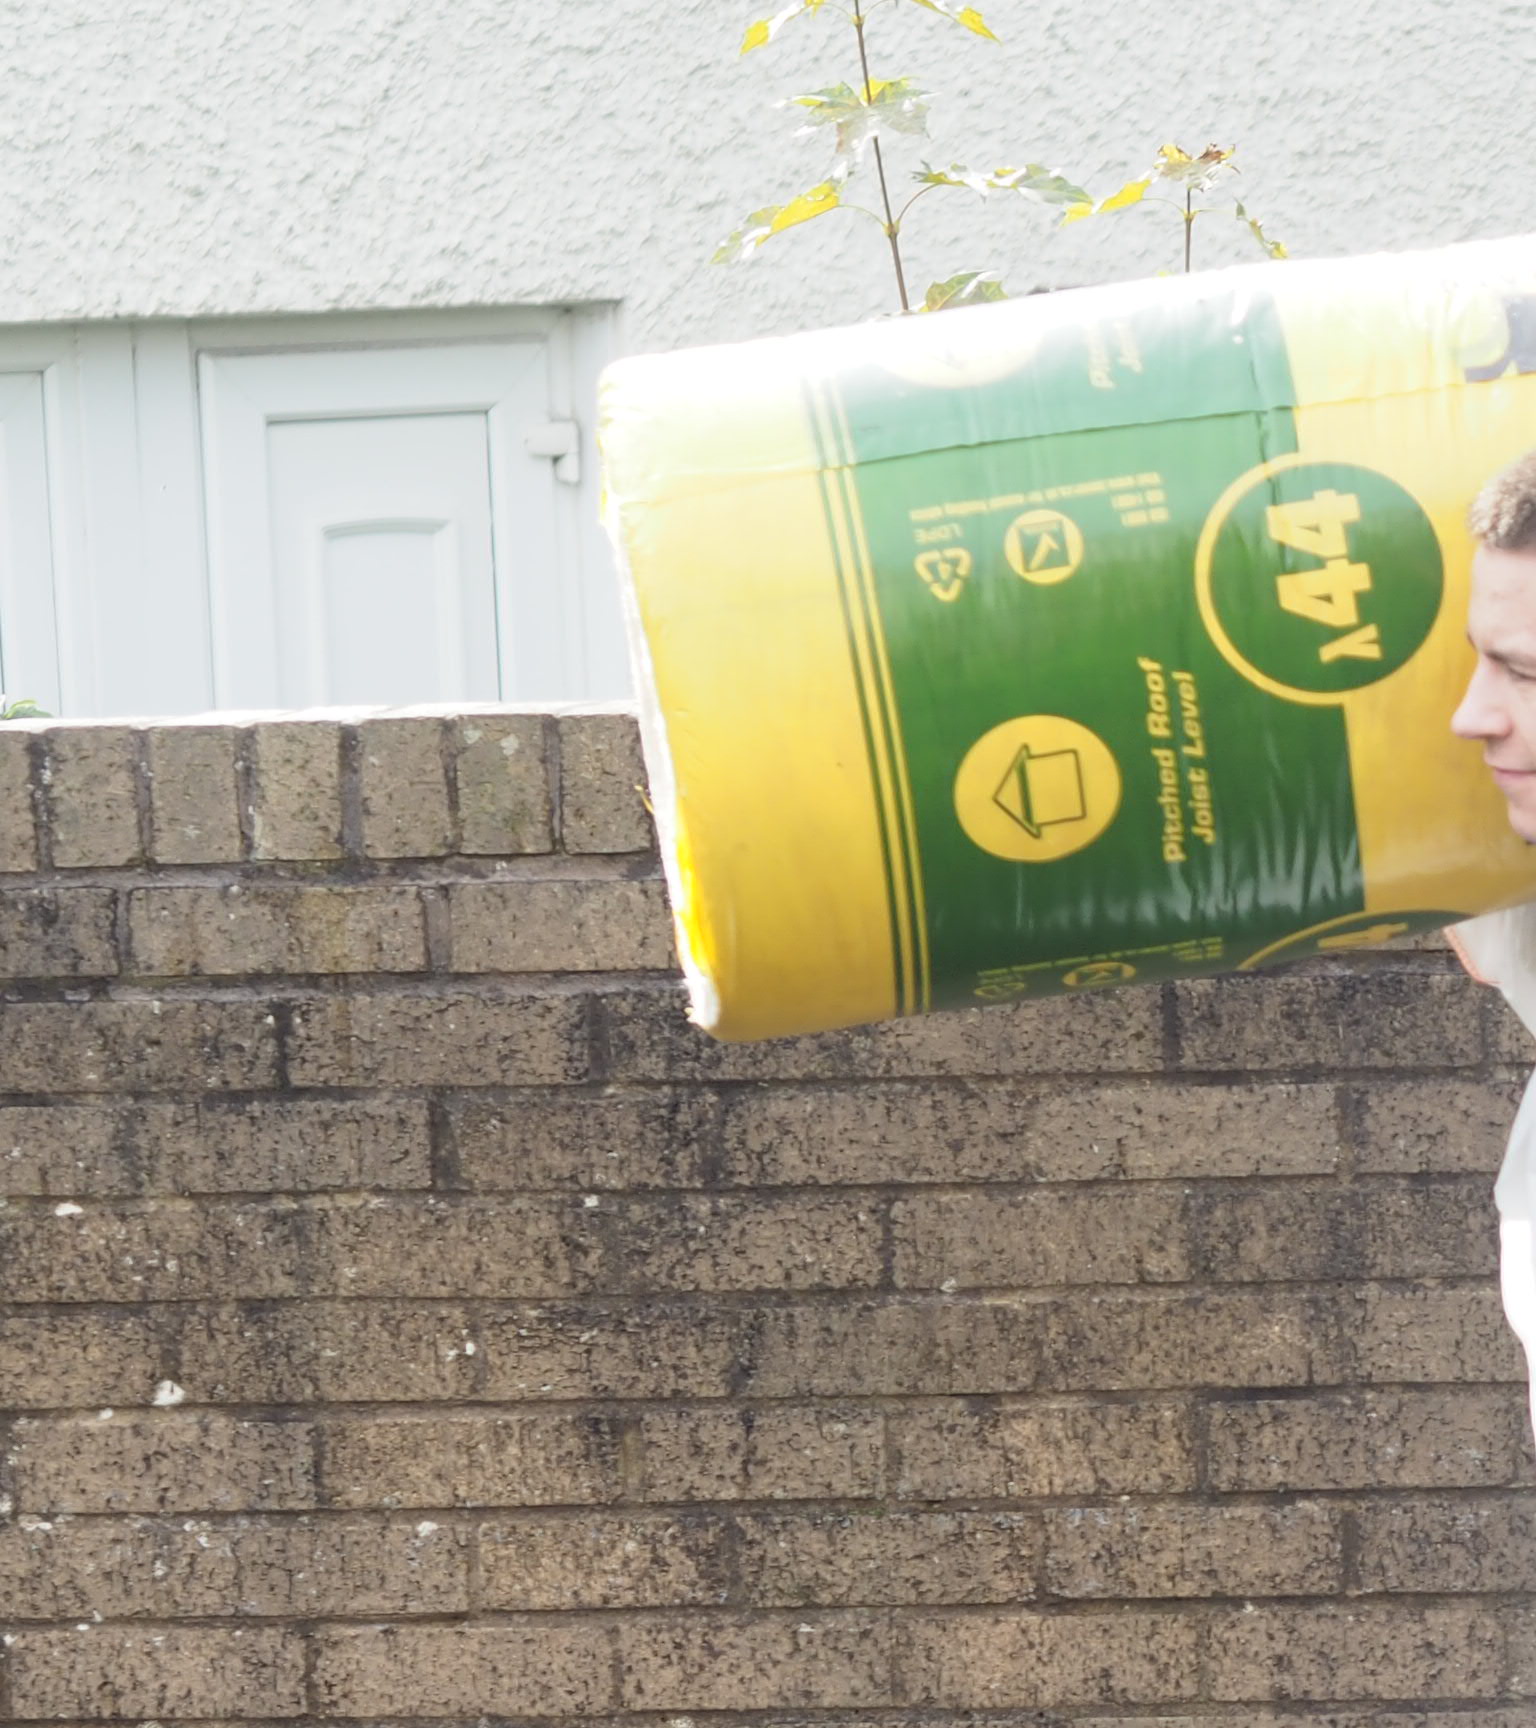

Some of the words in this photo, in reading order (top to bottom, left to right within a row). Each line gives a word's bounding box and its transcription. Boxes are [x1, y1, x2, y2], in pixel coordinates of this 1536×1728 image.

[1136, 656, 1173, 738] Roof
[1170, 671, 1206, 759] Level
[1151, 747, 1187, 863] Pitched
[1187, 766, 1217, 845] Joist
